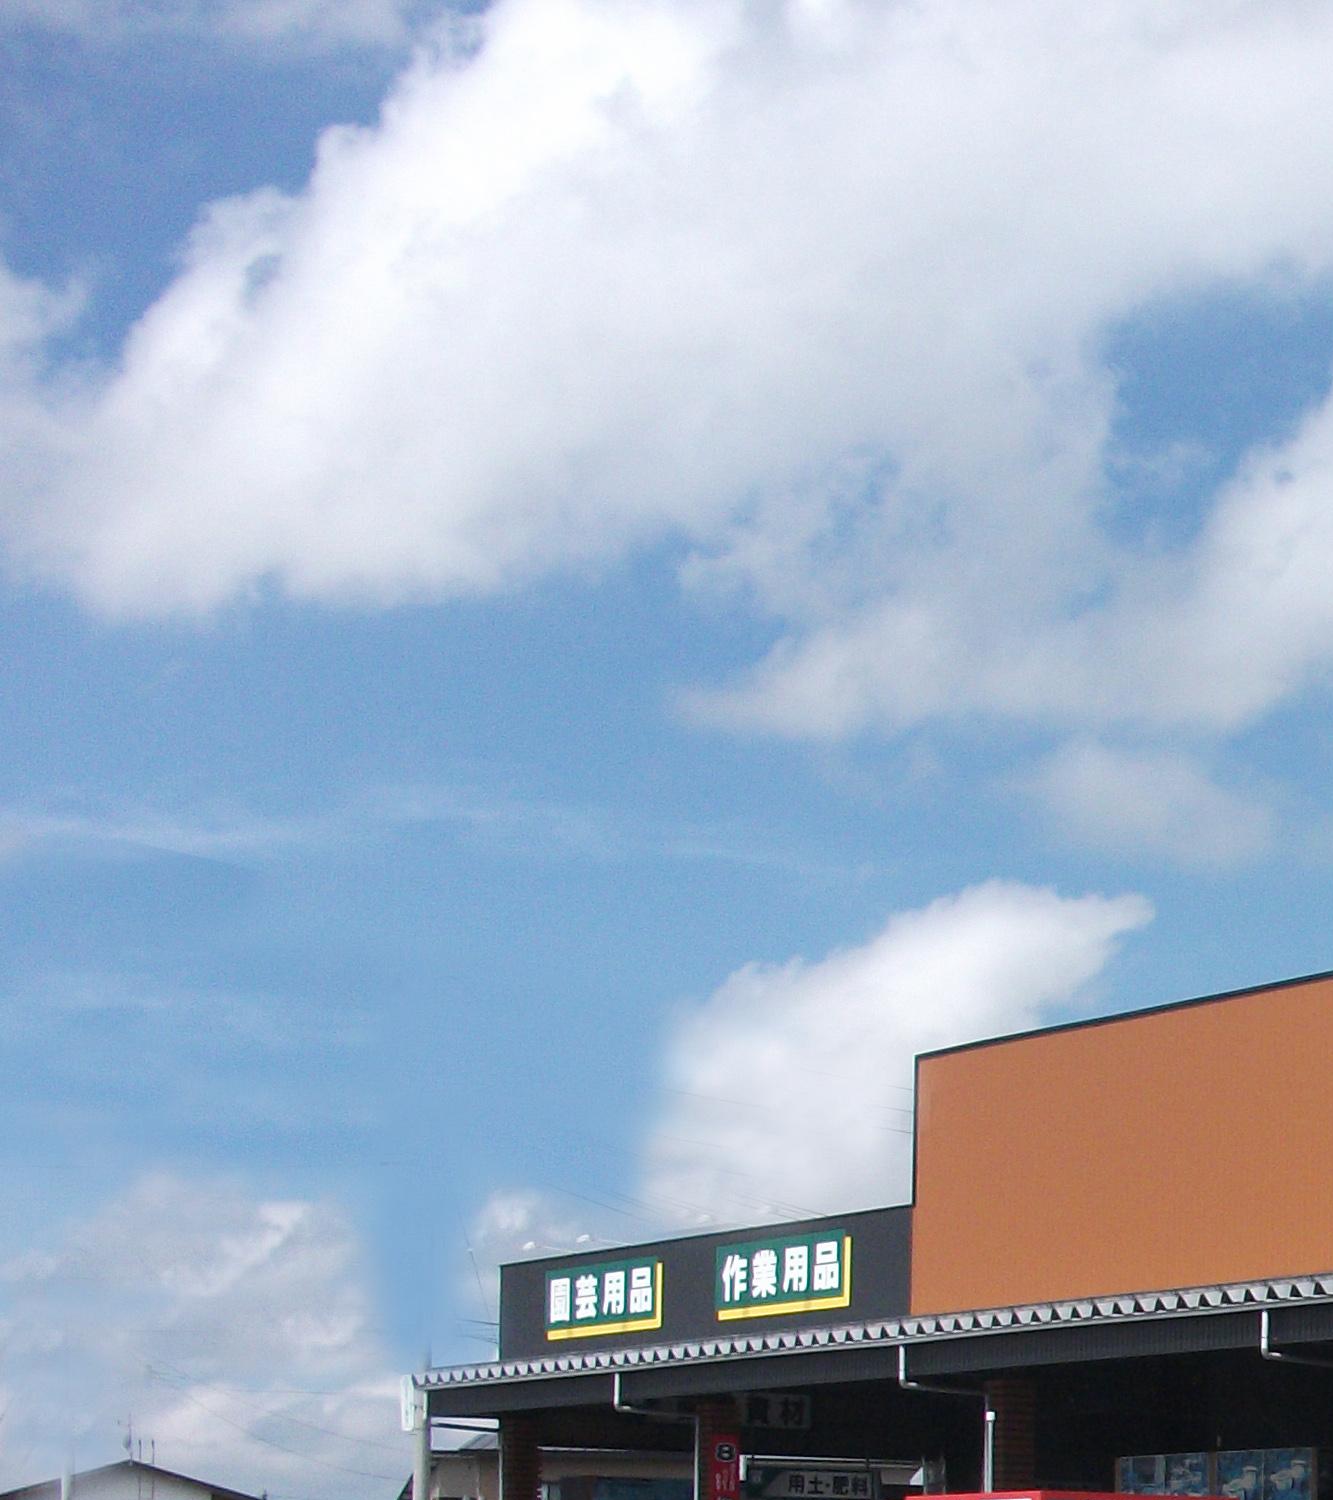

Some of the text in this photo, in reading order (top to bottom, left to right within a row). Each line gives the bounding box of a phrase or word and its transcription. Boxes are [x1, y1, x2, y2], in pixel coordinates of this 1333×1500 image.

[550, 1266, 652, 1324] 園芸用品
[722, 1241, 839, 1302] 作業用品
